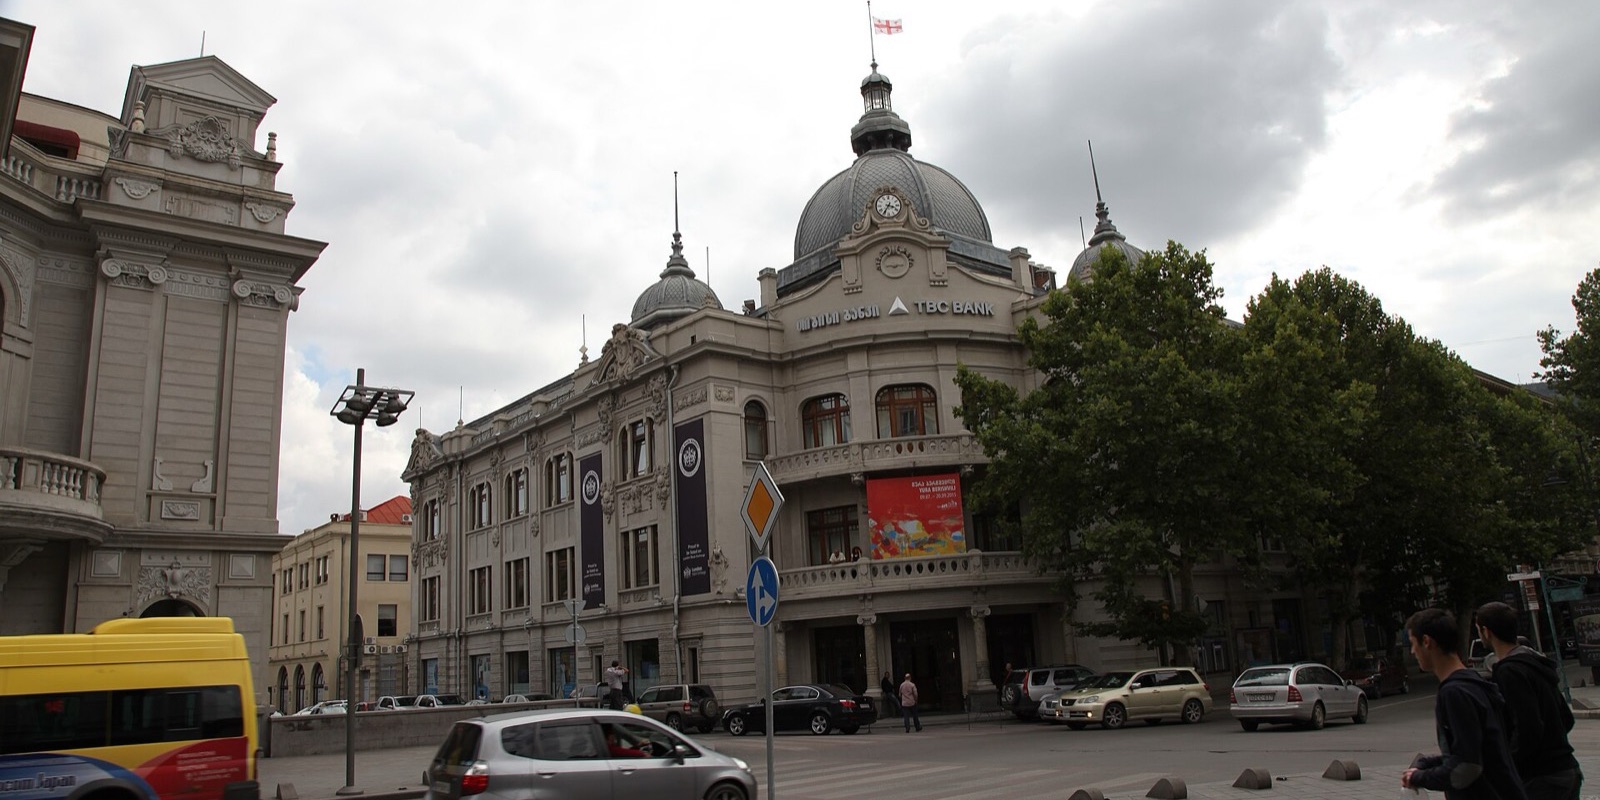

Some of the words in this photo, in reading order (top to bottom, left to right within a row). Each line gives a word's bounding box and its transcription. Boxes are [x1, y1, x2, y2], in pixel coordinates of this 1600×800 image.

[914, 300, 949, 313] TBC
[952, 300, 994, 316] BANK
[36, 772, 77, 793] Japan
